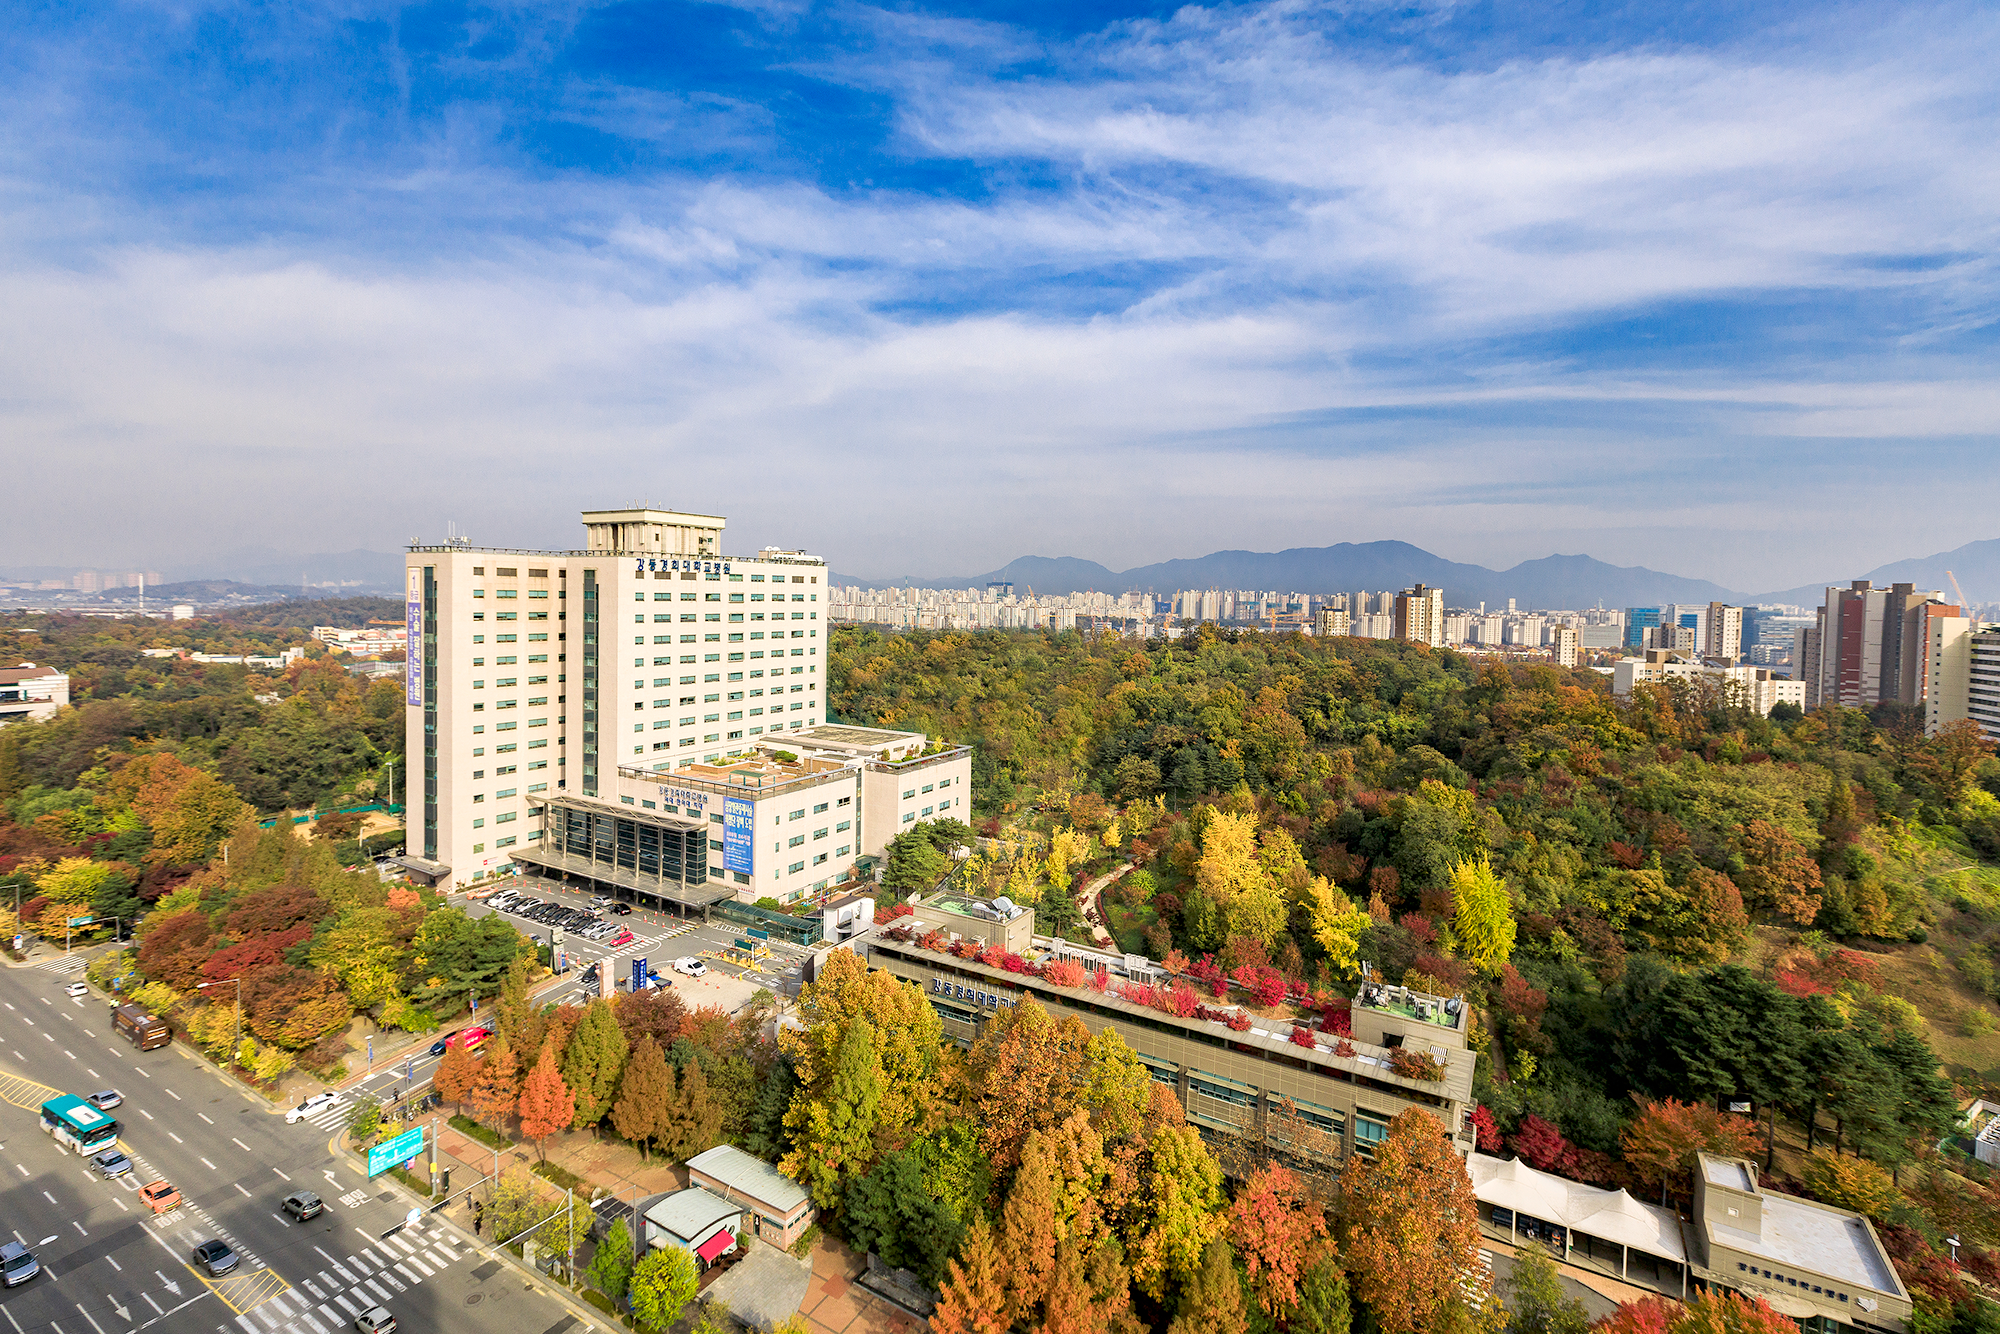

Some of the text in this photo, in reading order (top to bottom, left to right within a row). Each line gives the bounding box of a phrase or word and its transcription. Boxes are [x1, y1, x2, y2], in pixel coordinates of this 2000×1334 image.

[636, 558, 731, 575] 강동경희대학교병원
[413, 607, 421, 632] 수술
[413, 676, 421, 701] 병원
[659, 785, 709, 804] 강동경희대학교병원
[932, 977, 1018, 1009] 강동경희대학교
[338, 1188, 373, 1209] 병원
